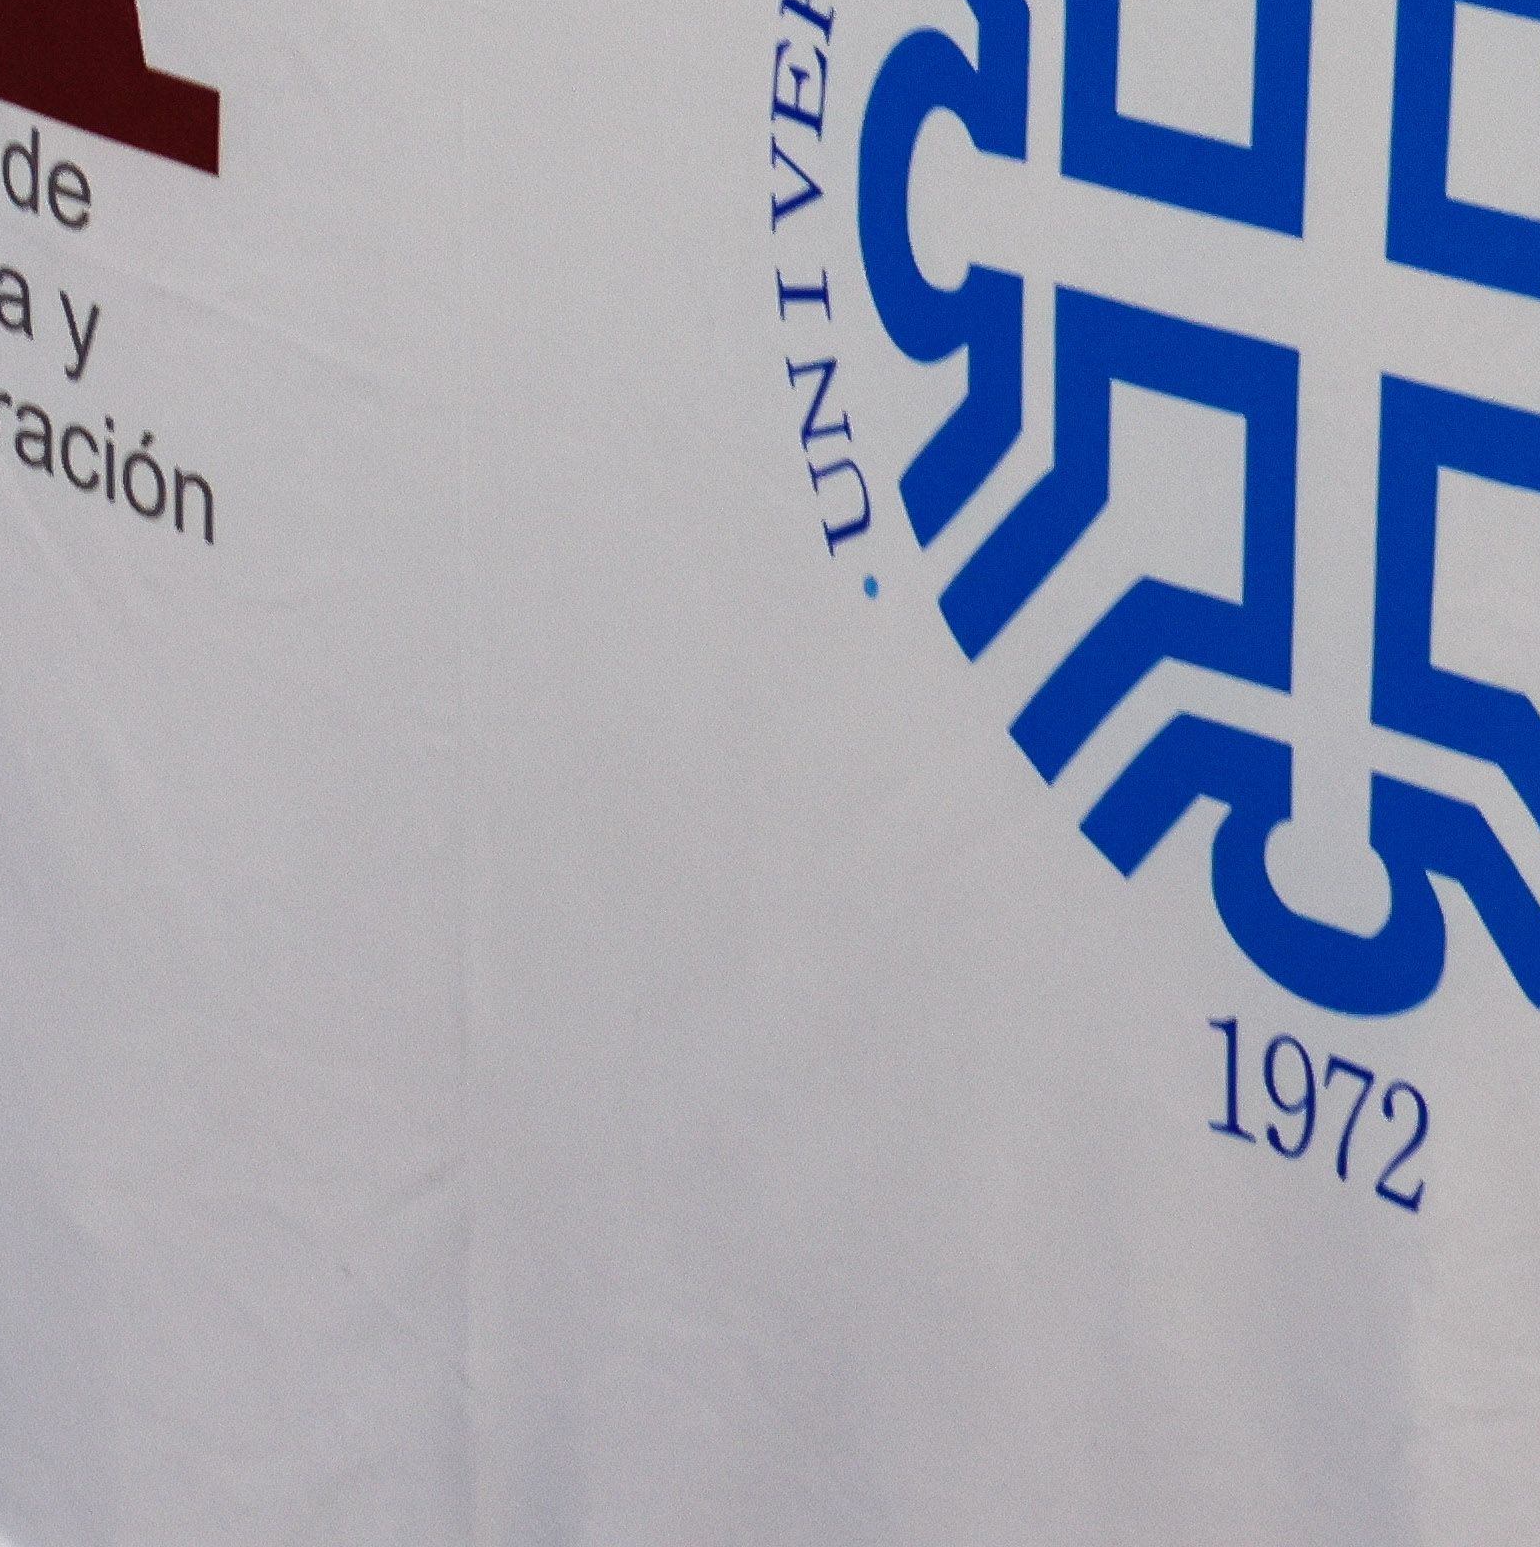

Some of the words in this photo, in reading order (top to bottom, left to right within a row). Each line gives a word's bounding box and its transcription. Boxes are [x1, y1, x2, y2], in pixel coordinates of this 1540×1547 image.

[0, 127, 92, 230] de
[58, 290, 101, 382] y
[1207, 1015, 1431, 1214] 1972
